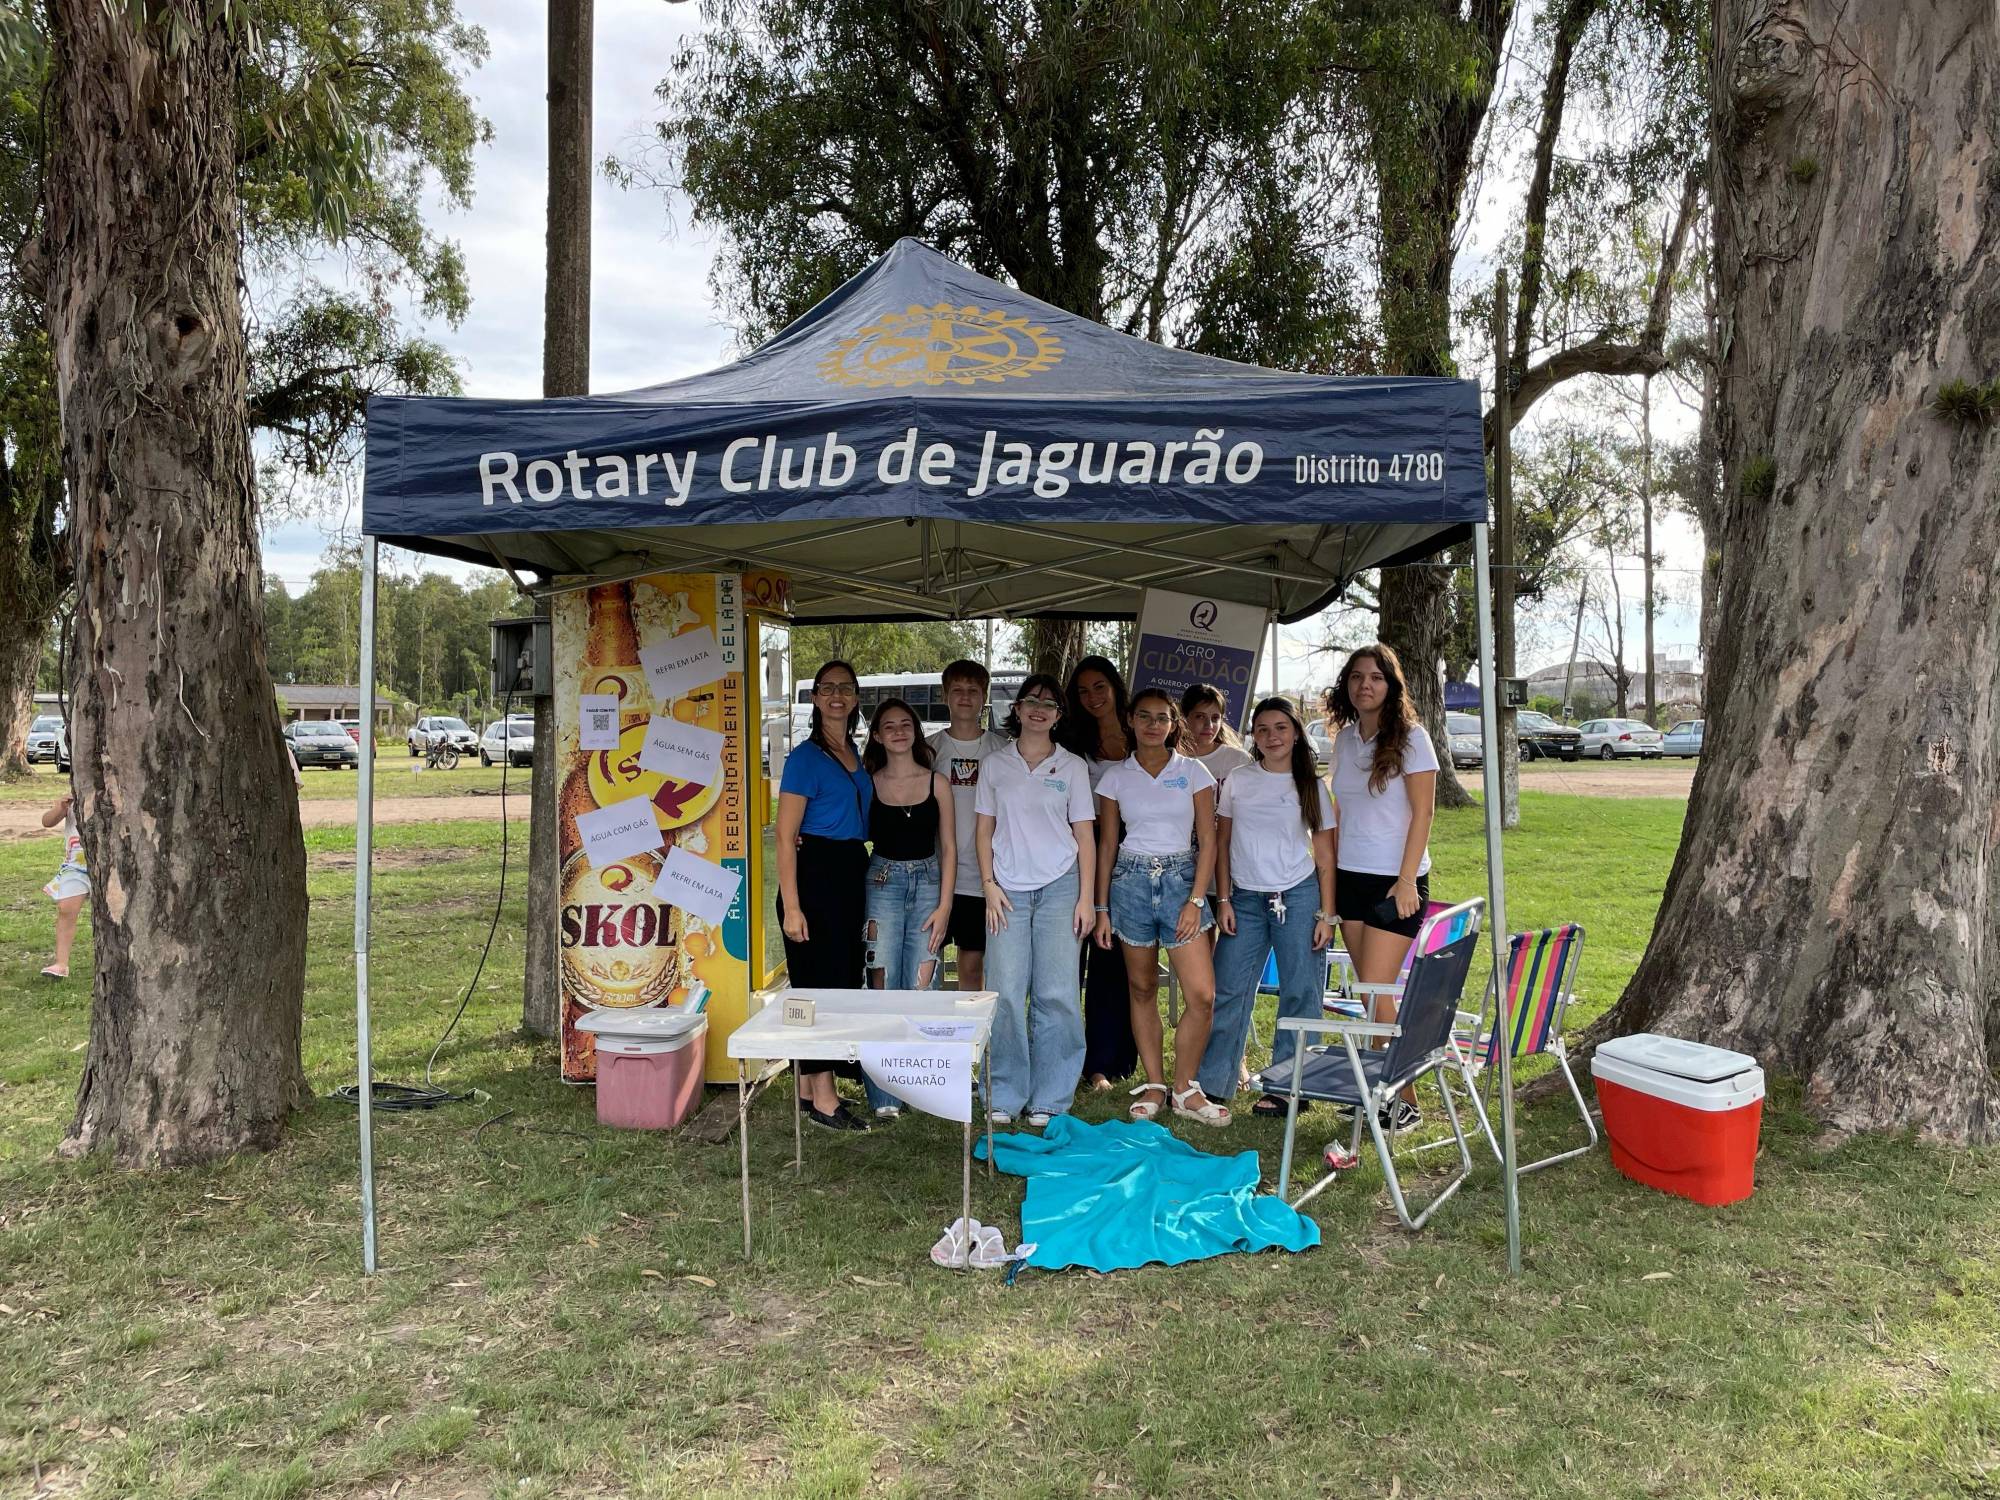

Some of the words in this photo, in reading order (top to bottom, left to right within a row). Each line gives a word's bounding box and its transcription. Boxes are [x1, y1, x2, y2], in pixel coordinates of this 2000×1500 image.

[478, 449, 697, 506] Rotary
[719, 432, 857, 493] Club
[877, 427, 955, 486] de
[967, 427, 1264, 499] Jaguarão
[1295, 453, 1380, 484] Distrito
[1387, 451, 1444, 482] 4780
[721, 579, 735, 664] GELADA
[655, 663, 675, 675] REFRI
[676, 658, 690, 668] EM
[690, 651, 709, 664] LATA
[1175, 643, 1216, 660] AGRO
[1143, 651, 1250, 685] CIDADÃO
[1157, 678, 1192, 689] QUERO-Q
[677, 745, 693, 756] SEM
[724, 678, 740, 852] REDONDAMENTE
[613, 824, 632, 836] COM
[632, 817, 649, 829] GÁS
[670, 871, 691, 885] REFRI
[691, 881, 705, 892] EM
[704, 886, 723, 899] LATA
[561, 903, 677, 948] SKOL
[788, 1007, 806, 1020] JBL
[881, 1058, 934, 1069] INTERACT
[937, 1059, 951, 1069] DE
[887, 1074, 946, 1086] JAGUARÃO
